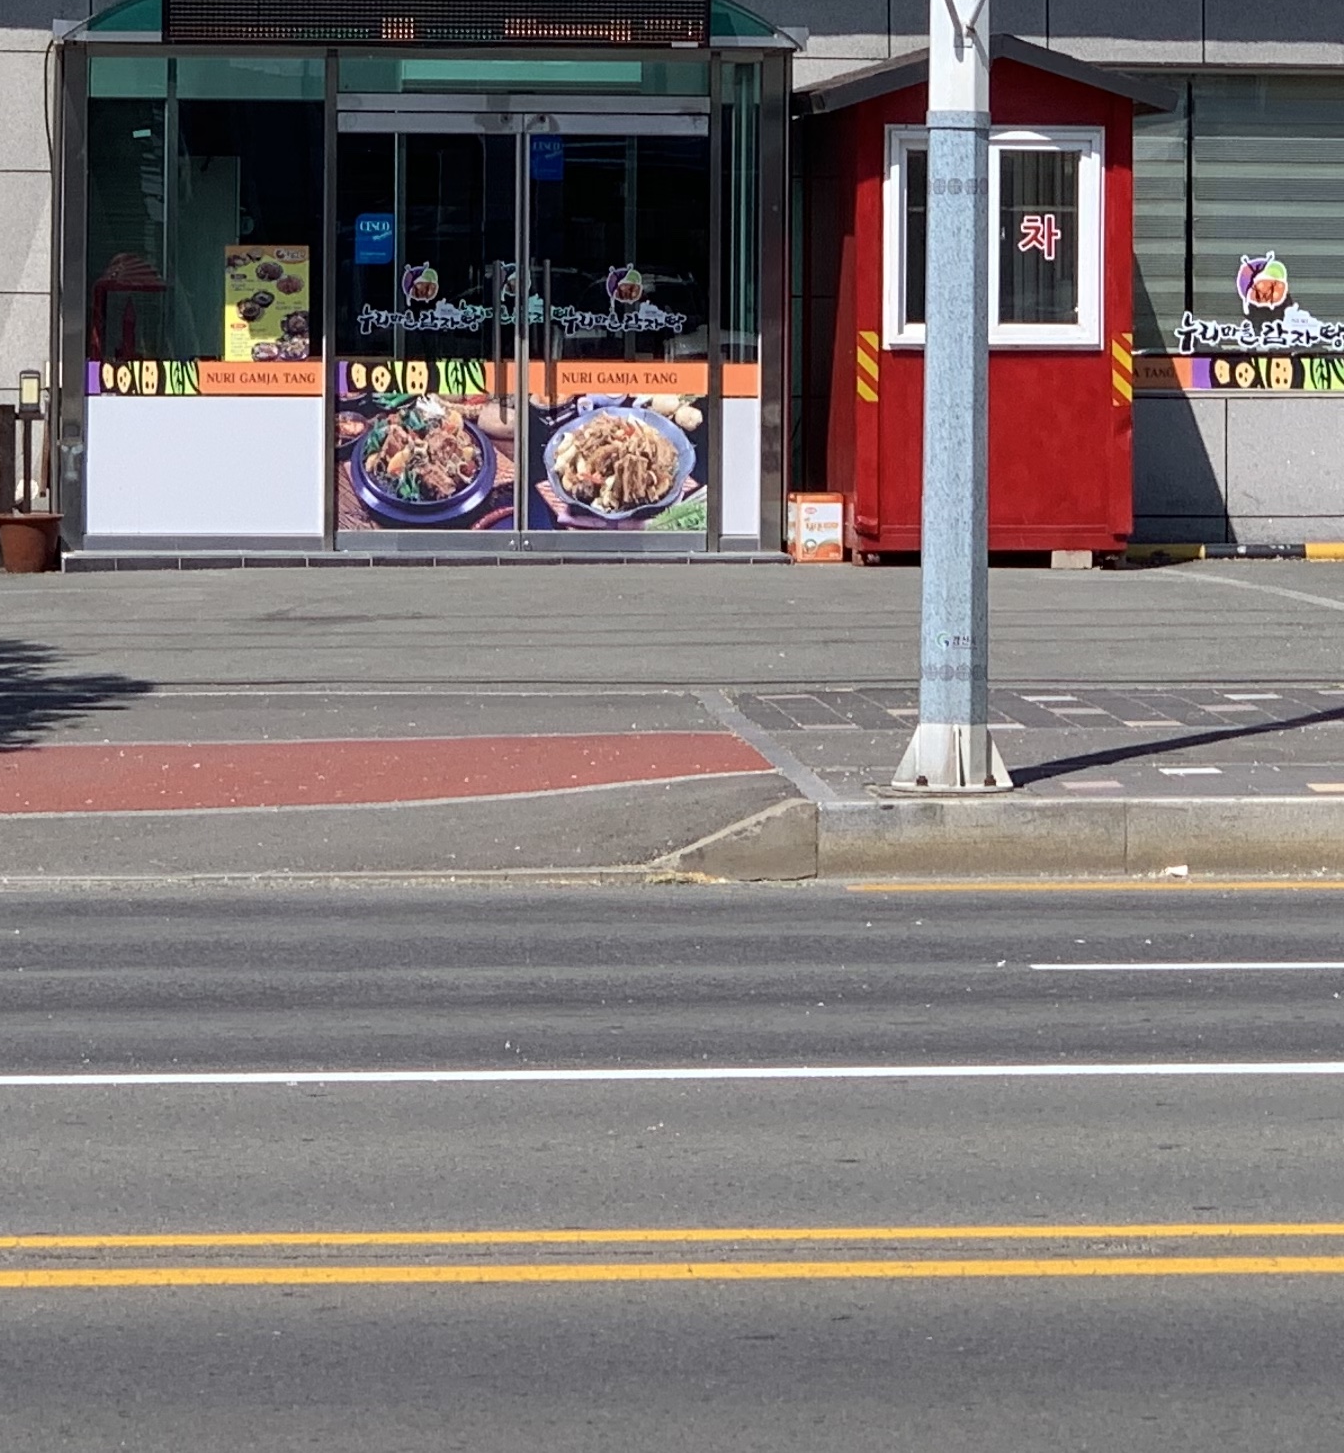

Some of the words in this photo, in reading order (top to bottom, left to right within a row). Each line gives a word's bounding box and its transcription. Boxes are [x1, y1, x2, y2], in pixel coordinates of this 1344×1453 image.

[359, 220, 390, 232] CESCO
[1017, 213, 1061, 260] 차
[206, 372, 235, 383] NURI
[239, 372, 278, 385] GAMJA
[283, 372, 315, 384] TANG
[562, 372, 592, 384] NURI
[597, 372, 639, 385] GAMJA
[643, 372, 678, 384] TANG
